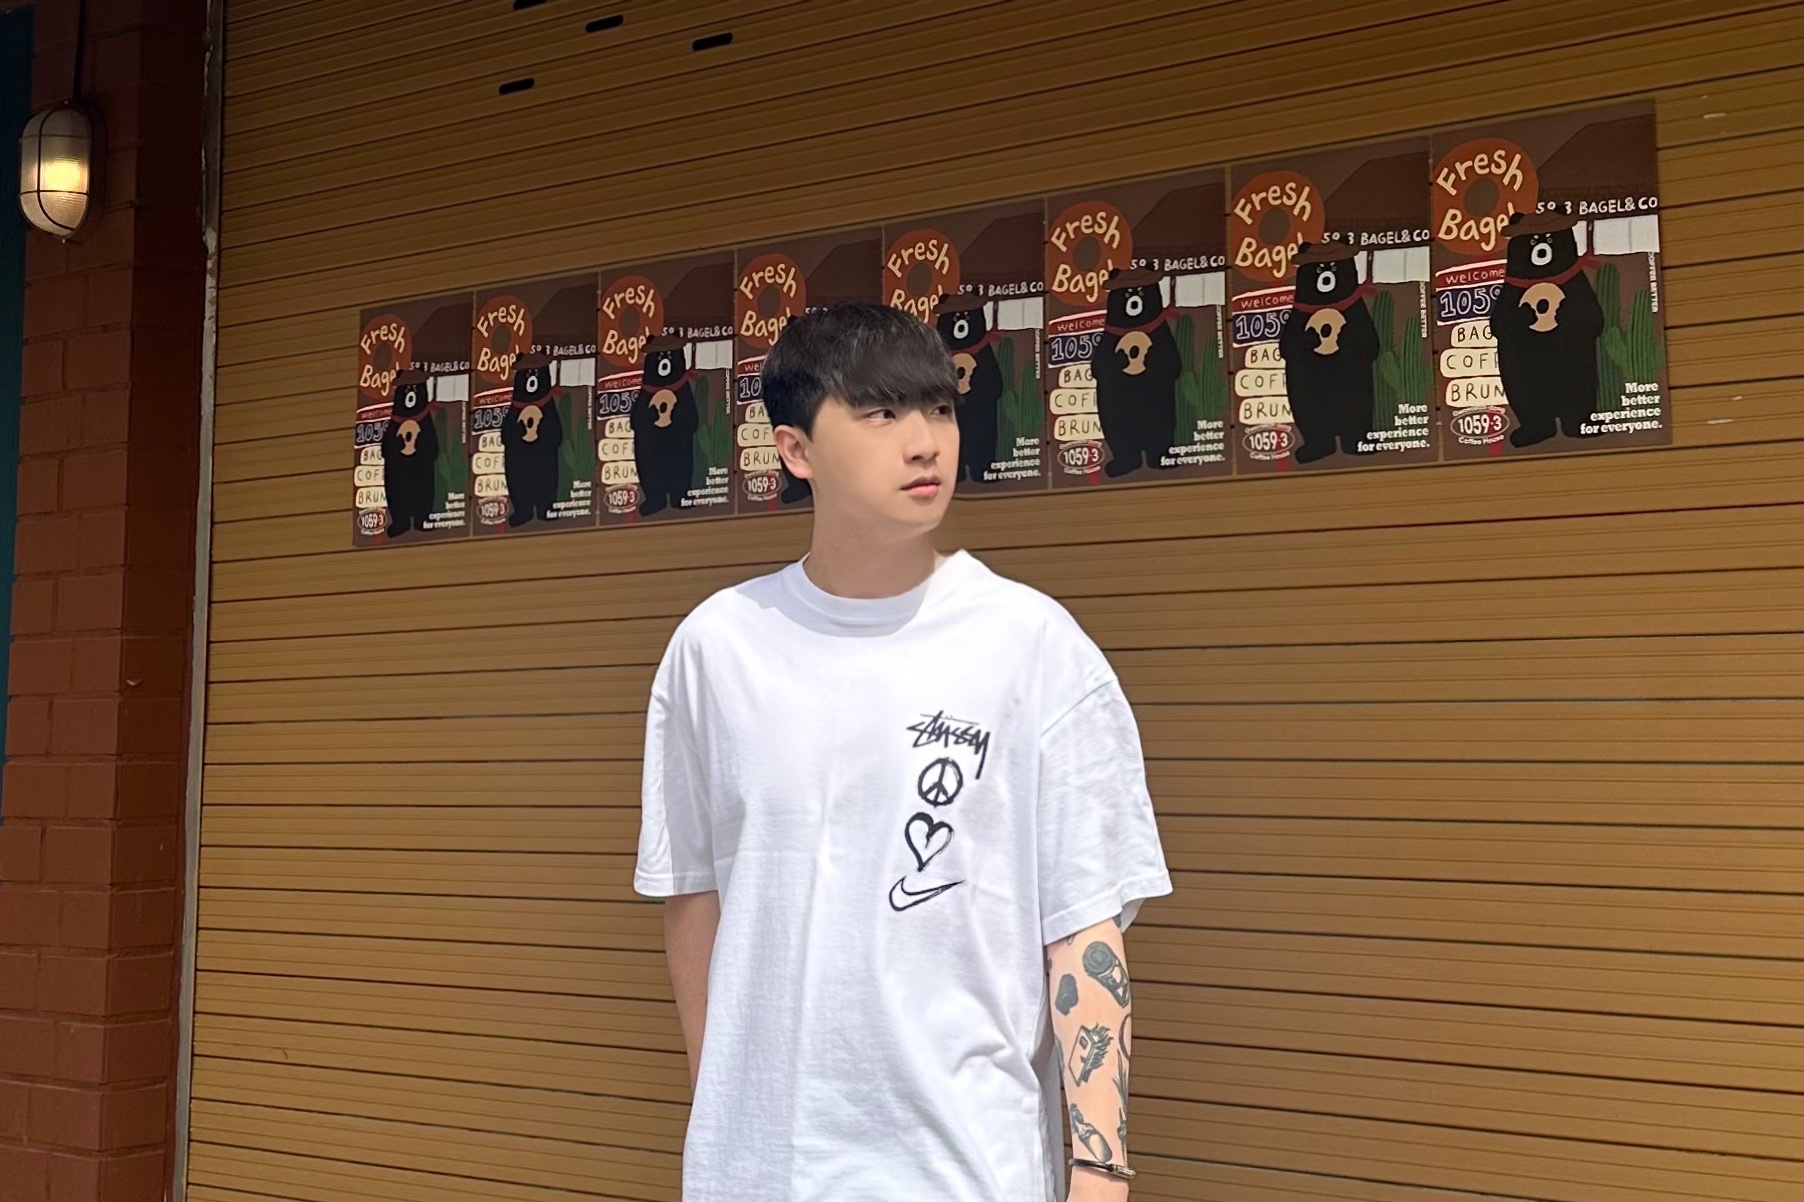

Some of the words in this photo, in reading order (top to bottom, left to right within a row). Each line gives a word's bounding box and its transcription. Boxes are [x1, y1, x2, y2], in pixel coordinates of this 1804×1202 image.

[1436, 150, 1523, 195] Fresh
[1234, 182, 1311, 224] Fresh
[1051, 212, 1120, 252] Fresh
[887, 239, 949, 277] Fresh
[739, 264, 796, 299] Fresh
[1446, 269, 1504, 284] welcome
[603, 285, 656, 319] Fresh
[1241, 295, 1293, 308] welcome
[477, 304, 525, 337] Fresh
[1056, 318, 1104, 331] welcome
[360, 323, 404, 354] Fresh
[1626, 382, 1658, 393] More
[1622, 395, 1660, 406] better
[1398, 404, 1427, 414] More
[1590, 408, 1661, 422] experience
[1197, 420, 1222, 429] More
[1394, 416, 1428, 426] better
[1580, 424, 1600, 434] for
[1601, 420, 1662, 433] everyone.
[1194, 431, 1223, 441] better
[1366, 428, 1429, 440] experience
[1358, 442, 1374, 452] for
[1376, 439, 1429, 451] everyone.
[1161, 456, 1176, 466] for
